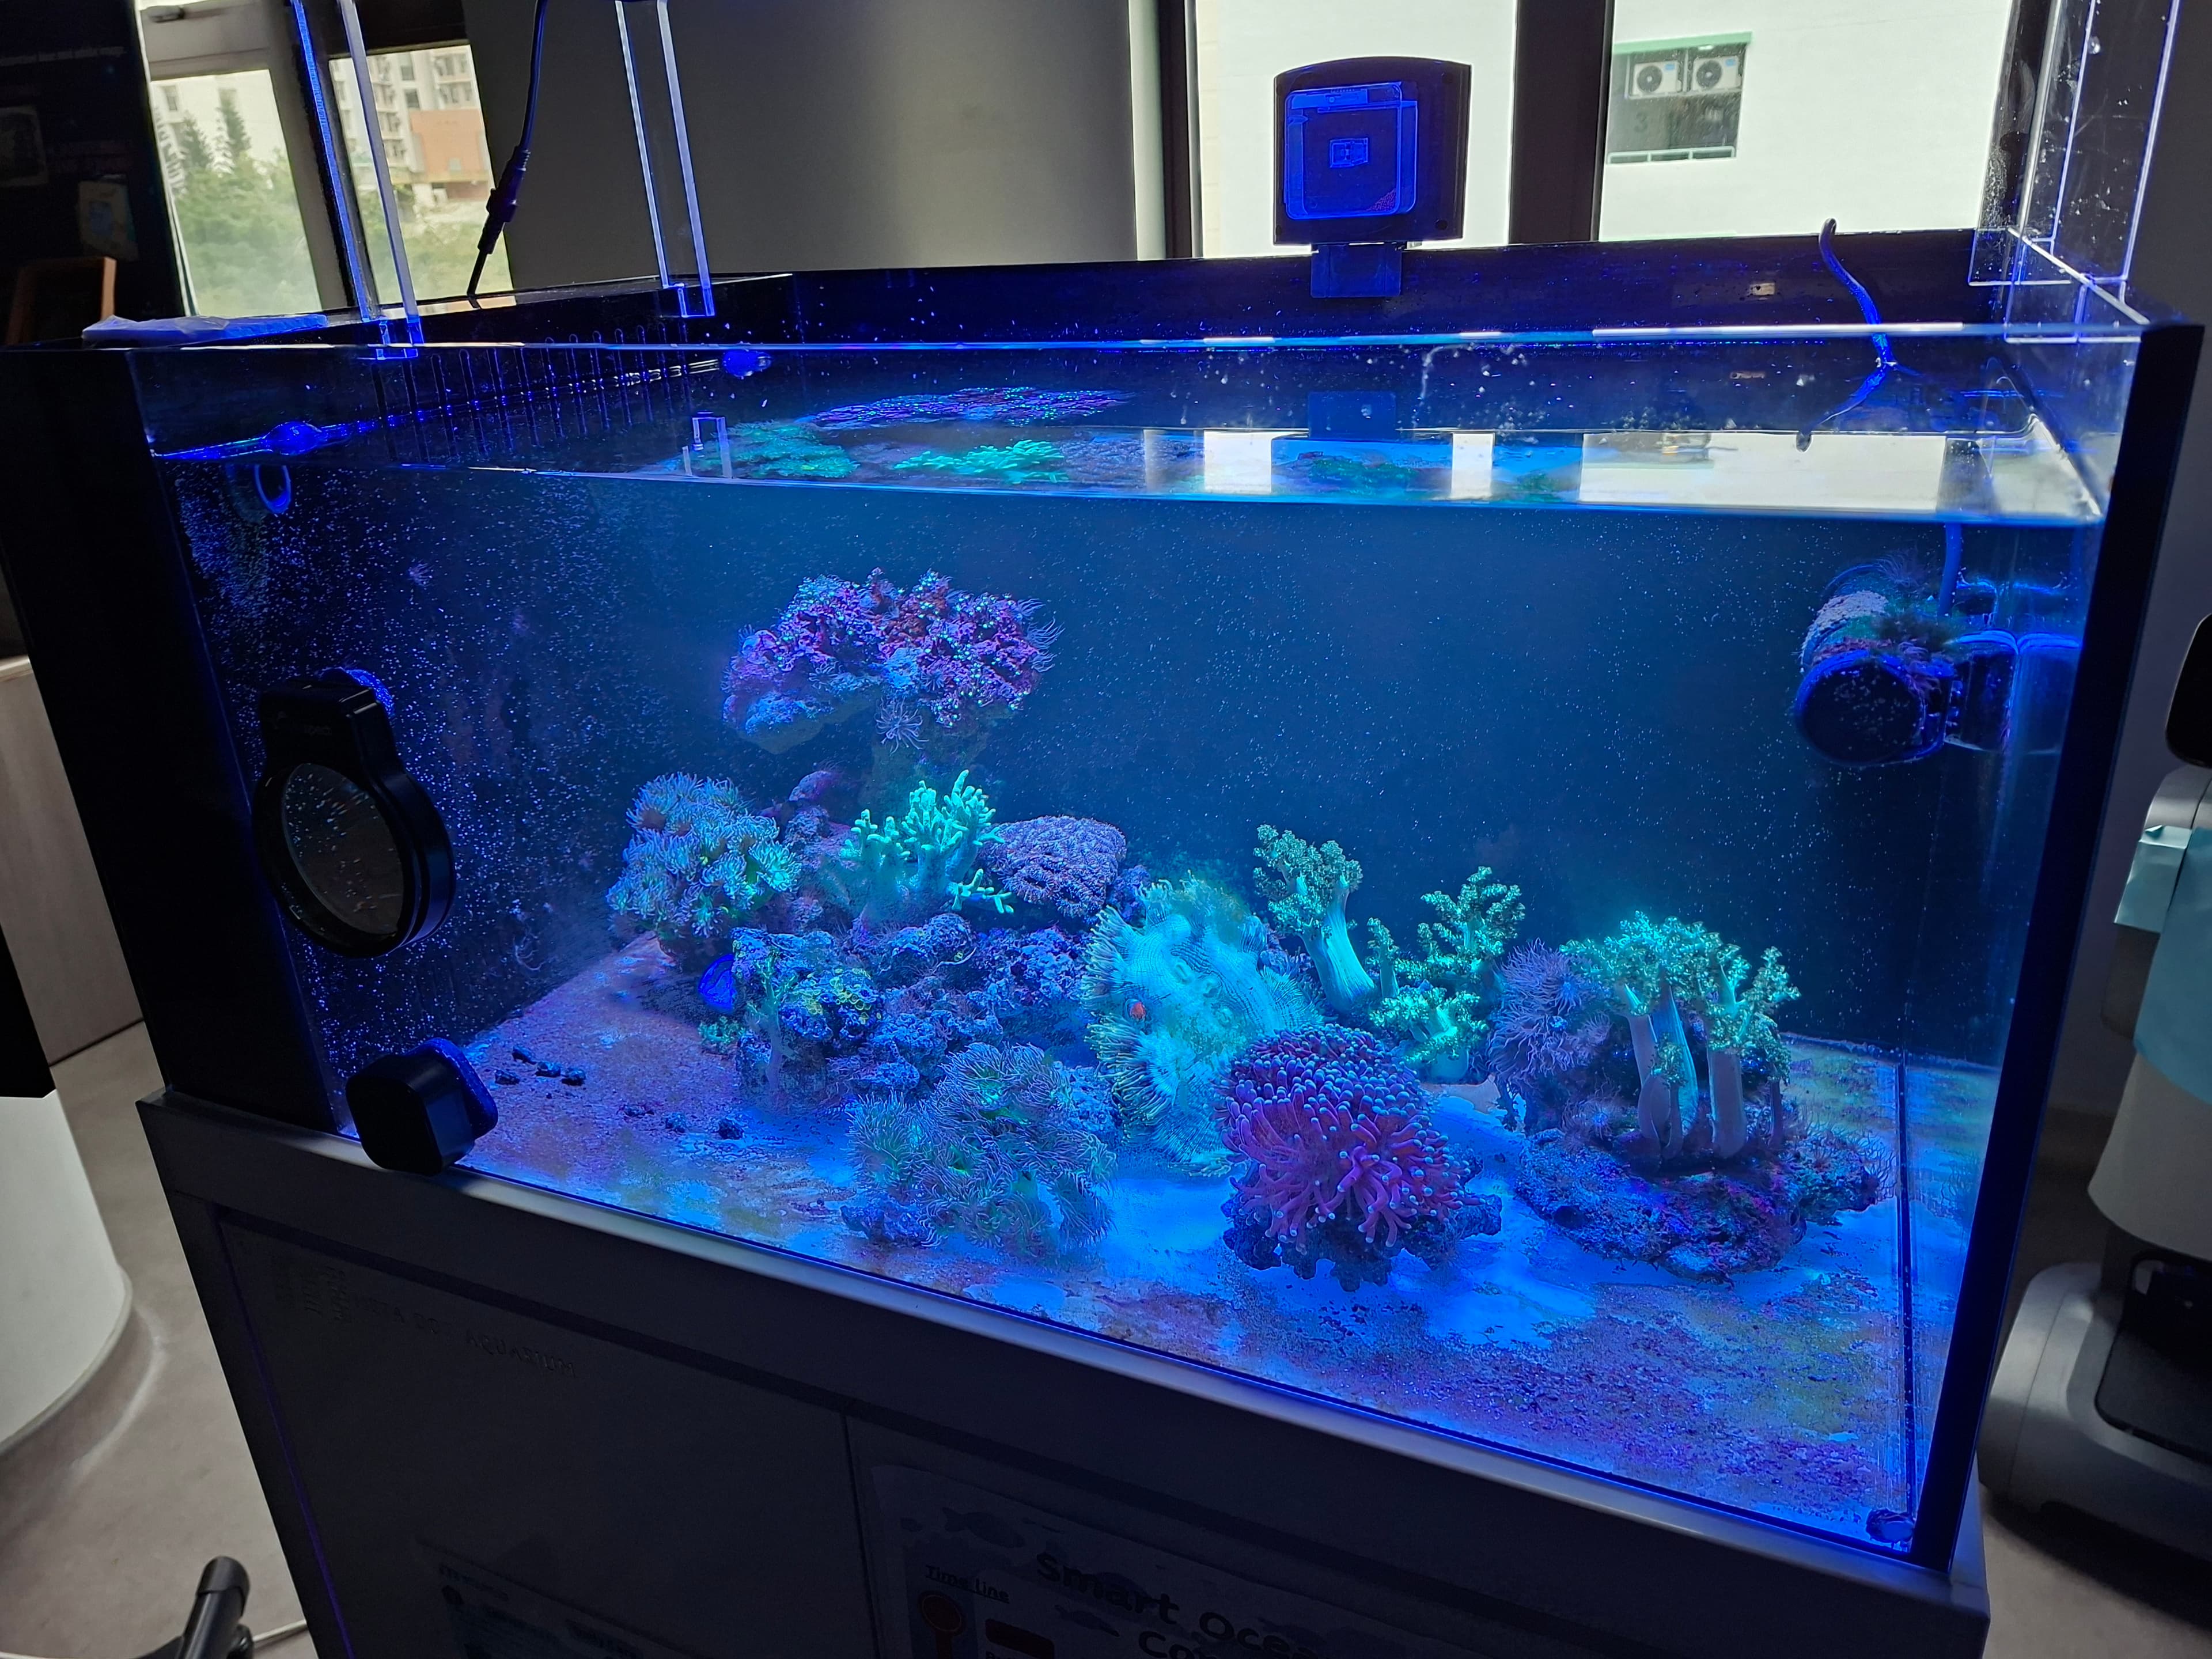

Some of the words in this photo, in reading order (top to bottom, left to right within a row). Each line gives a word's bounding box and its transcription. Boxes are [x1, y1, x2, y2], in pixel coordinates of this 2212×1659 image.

[925, 1564, 968, 1590] Time
[975, 1578, 1010, 1603] line
[1036, 1552, 1180, 1625] Smart
[1198, 1611, 1331, 1659] Ocea
